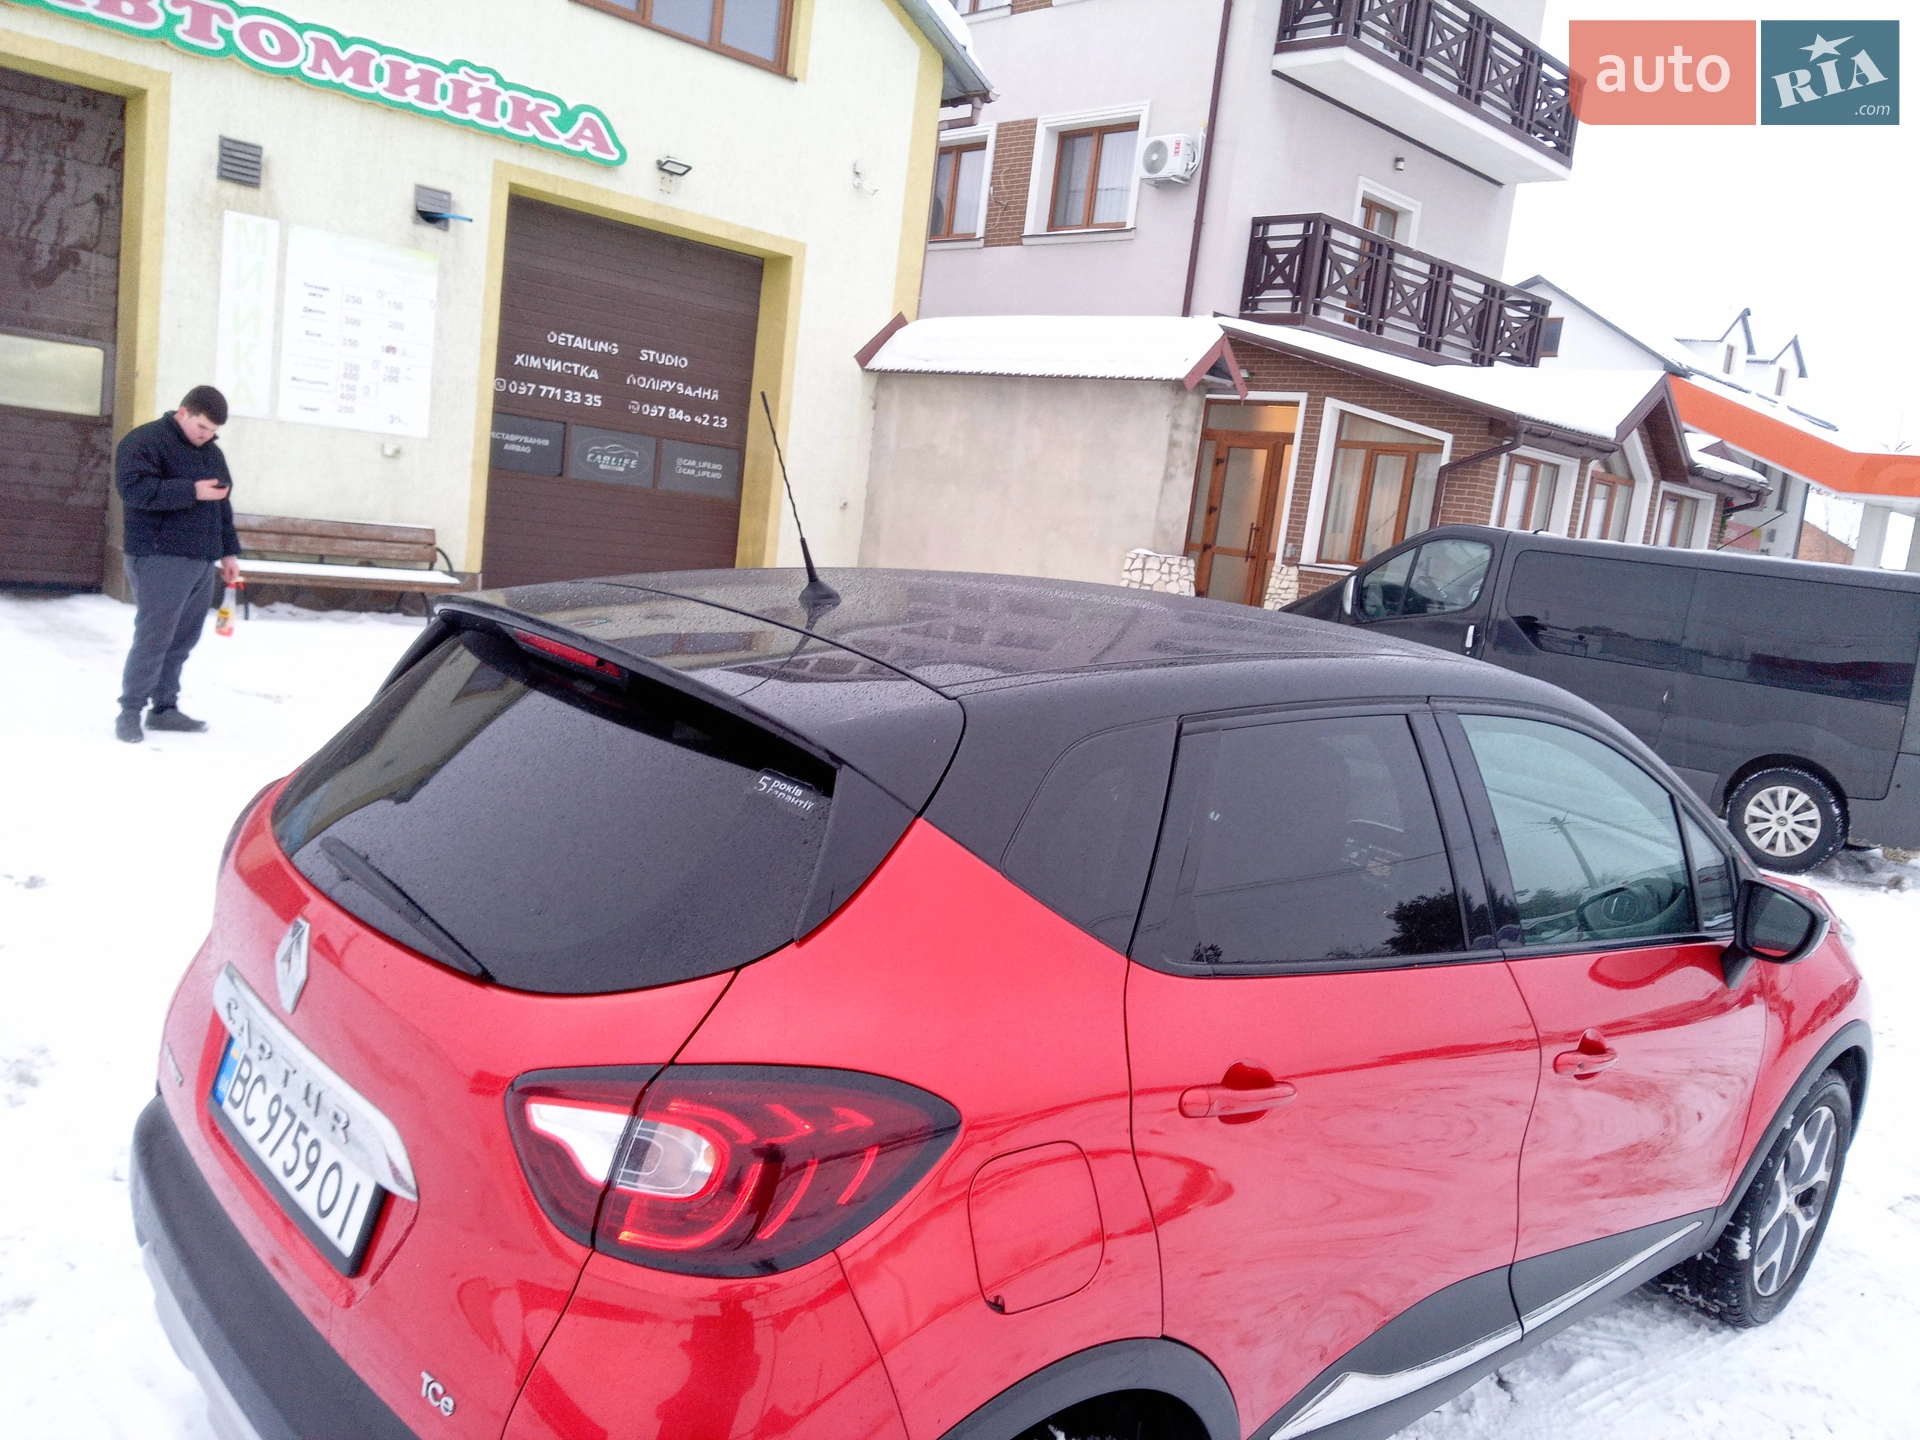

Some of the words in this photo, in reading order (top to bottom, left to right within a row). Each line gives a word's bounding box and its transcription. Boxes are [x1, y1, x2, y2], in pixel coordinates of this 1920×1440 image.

[52, 0, 617, 155] ВТОМИЙКА
[547, 331, 619, 354] DETAILING
[639, 349, 689, 368] STUDIO
[514, 353, 599, 380] ХІМЧИСТКА
[508, 380, 536, 396] 097
[539, 385, 562, 401] 771
[564, 390, 581, 404] 33
[584, 393, 602, 407] 35
[712, 415, 728, 428] 23
[758, 775, 772, 792] 5
[421, 1370, 455, 1417] TCe
